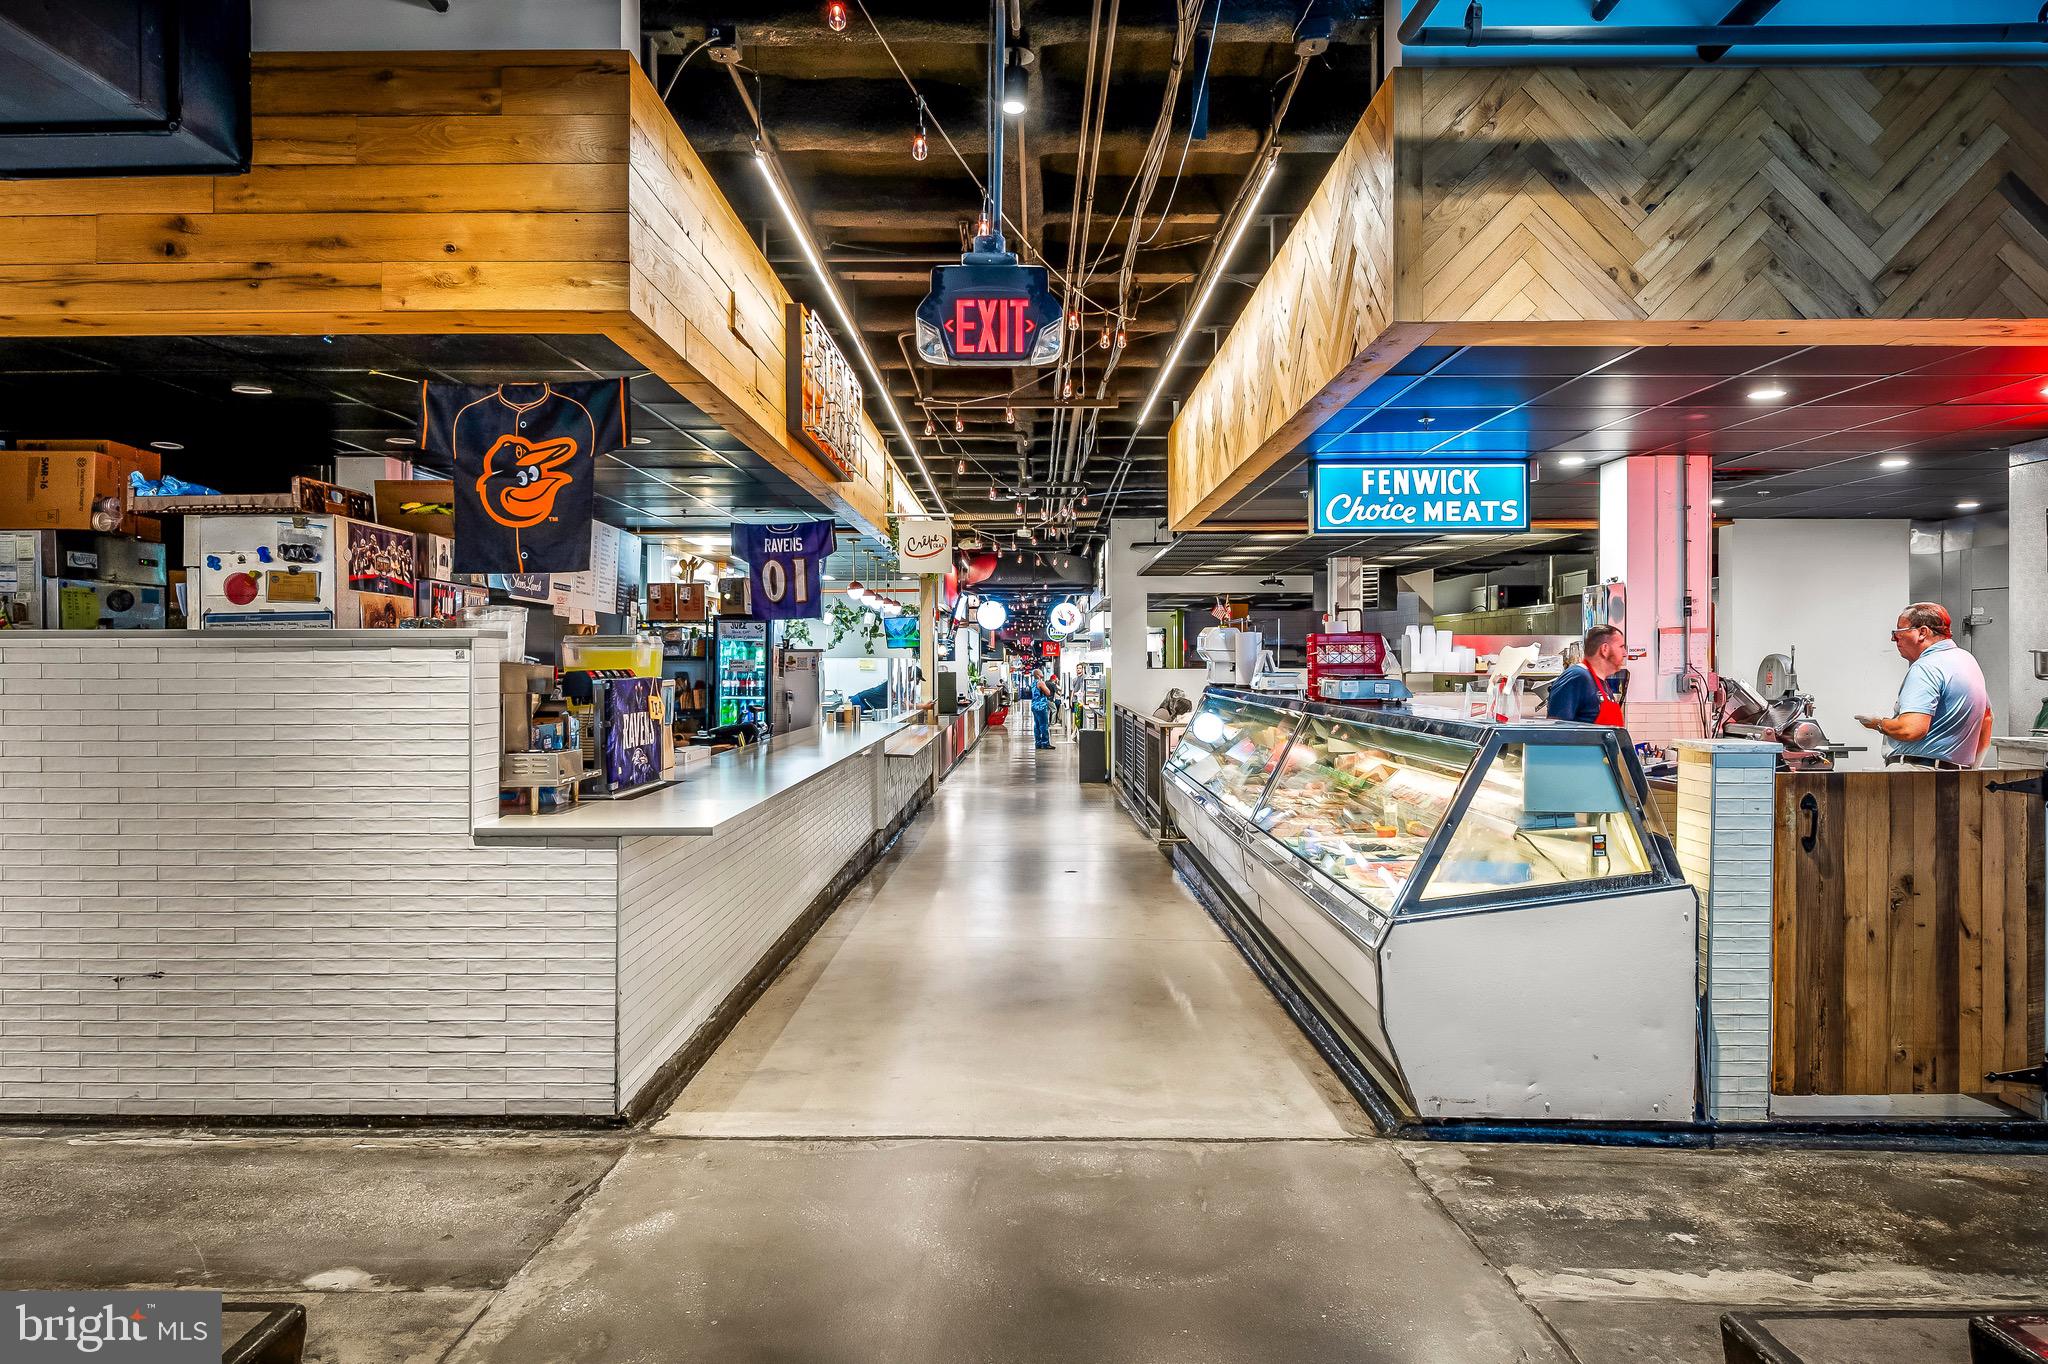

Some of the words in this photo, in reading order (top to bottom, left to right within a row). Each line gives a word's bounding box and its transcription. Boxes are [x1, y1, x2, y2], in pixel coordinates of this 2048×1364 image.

[956, 299, 1029, 353] EXIT
[40, 457, 49, 490] SMR-16
[1362, 469, 1480, 495] FENWICK
[1325, 493, 1416, 525] Choice
[1423, 499, 1518, 522] MEATS
[764, 537, 803, 553] RAVENS
[907, 534, 940, 552] Crêpe
[762, 557, 807, 603] 01
[622, 711, 655, 749] RAVENS
